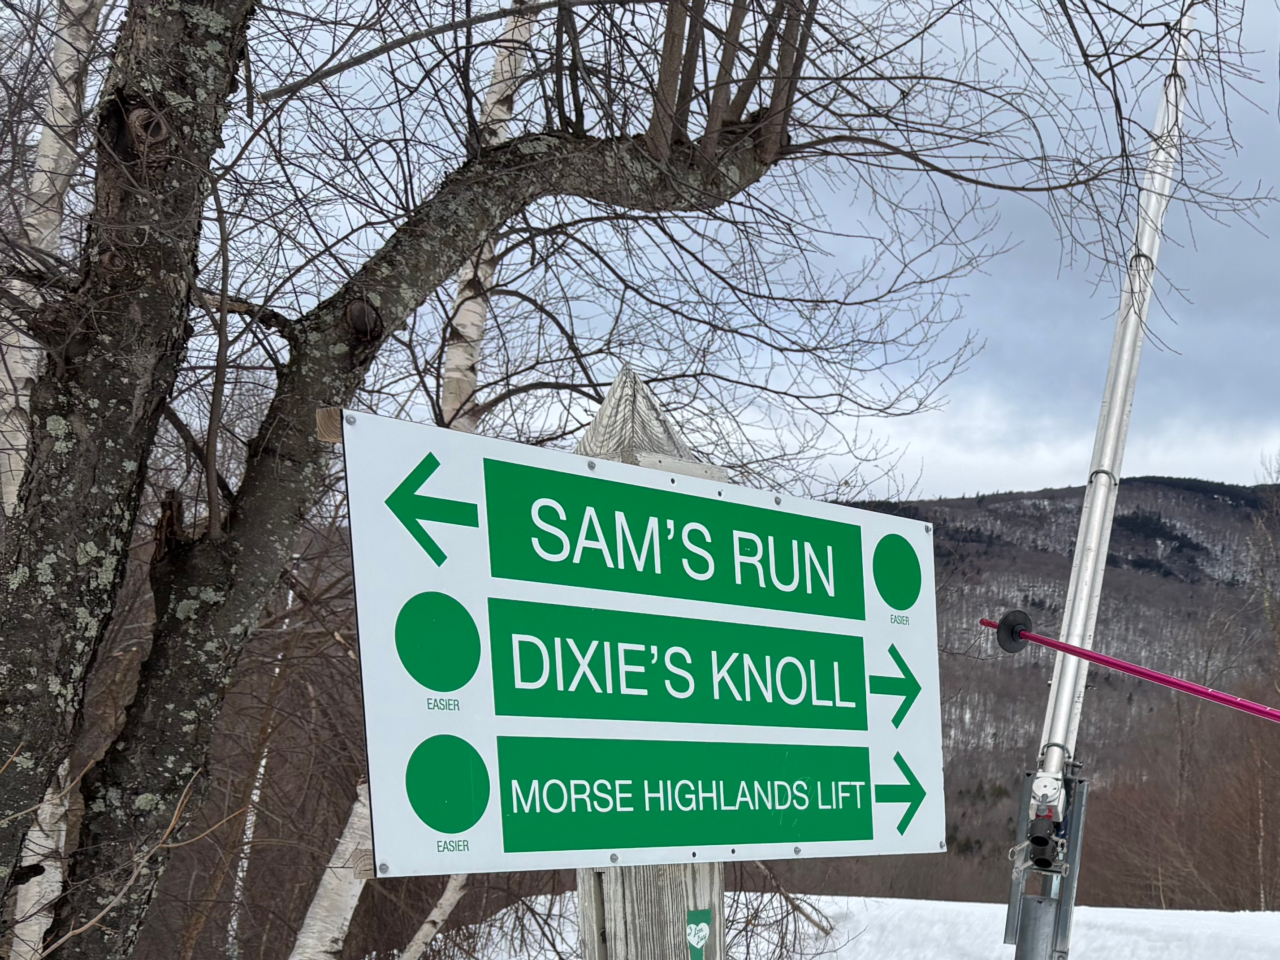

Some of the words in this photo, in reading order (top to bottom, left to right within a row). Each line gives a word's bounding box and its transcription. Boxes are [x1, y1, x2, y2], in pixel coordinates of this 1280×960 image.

[530, 497, 715, 581] SAM'S
[732, 529, 835, 598] RUN
[890, 614, 910, 626] EASIER
[511, 633, 696, 699] DIXIE'S
[710, 650, 857, 708] KNOLL
[426, 697, 460, 711] EASIER
[511, 778, 634, 814] MORSE
[643, 779, 810, 812] HIGHLANDS
[817, 780, 866, 810] LIFT
[436, 839, 470, 853] EASIER
